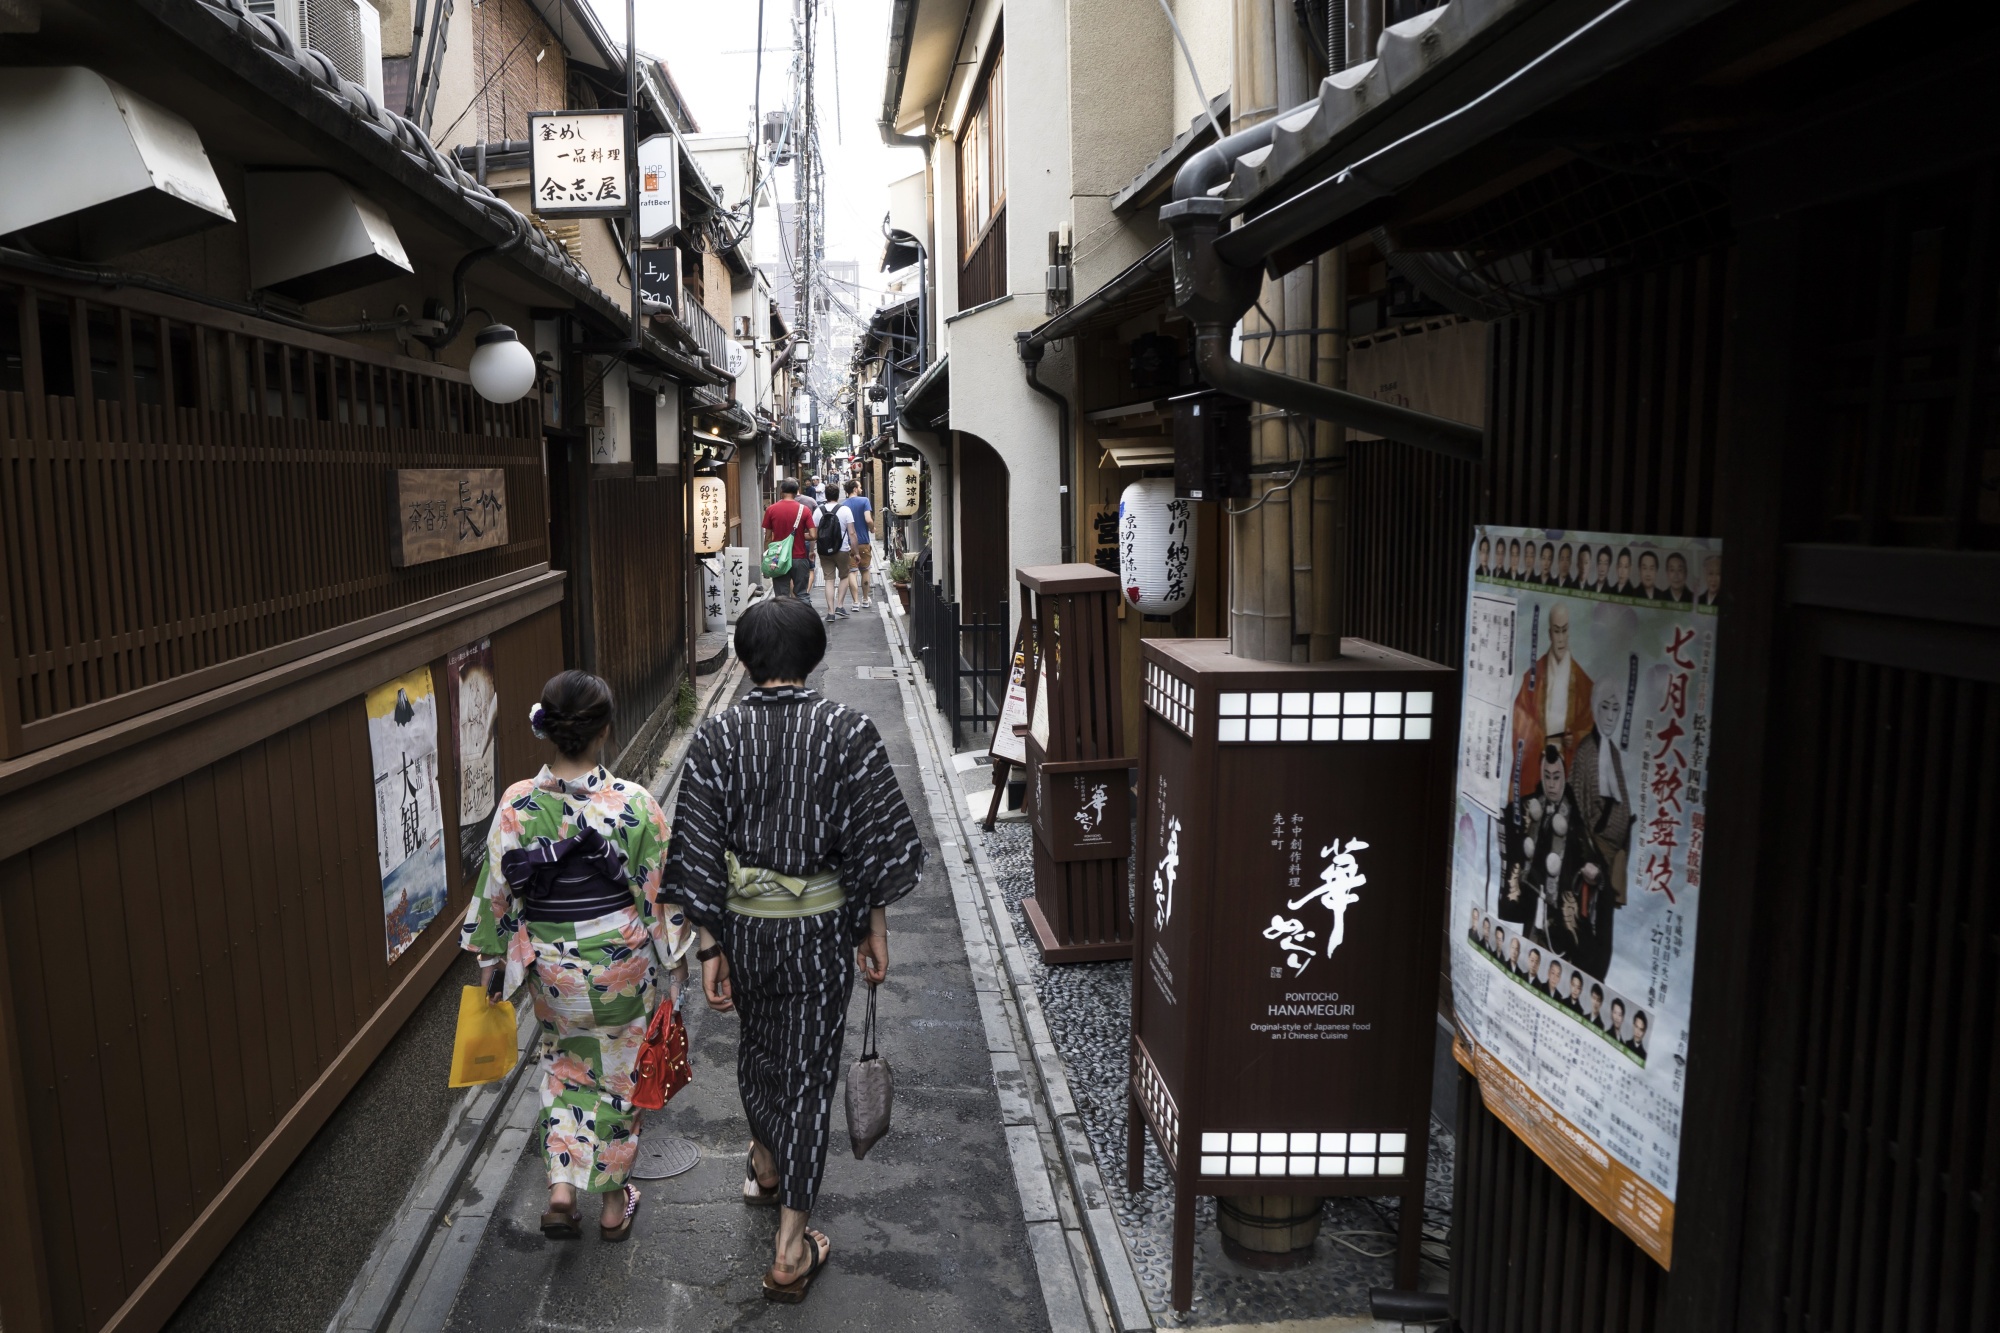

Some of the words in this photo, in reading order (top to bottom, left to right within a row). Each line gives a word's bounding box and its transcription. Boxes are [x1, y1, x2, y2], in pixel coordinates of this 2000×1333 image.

[540, 120, 586, 141] 釜めし
[557, 147, 620, 163] 一品料理
[539, 176, 621, 201] 余志屋
[397, 752, 422, 859] 大観
[1271, 812, 1286, 851] 先斗町
[1288, 813, 1304, 888] 和中創作料理
[1285, 992, 1339, 1002] PONTOCHO
[1268, 1004, 1355, 1016] HANAMEGURI
[1288, 1031, 1319, 1040] Chinese
[1320, 1031, 1349, 1040] Cuisine
[1303, 1022, 1312, 1030] of
[1313, 1023, 1351, 1032] Japanese
[1352, 1022, 1371, 1030] food
